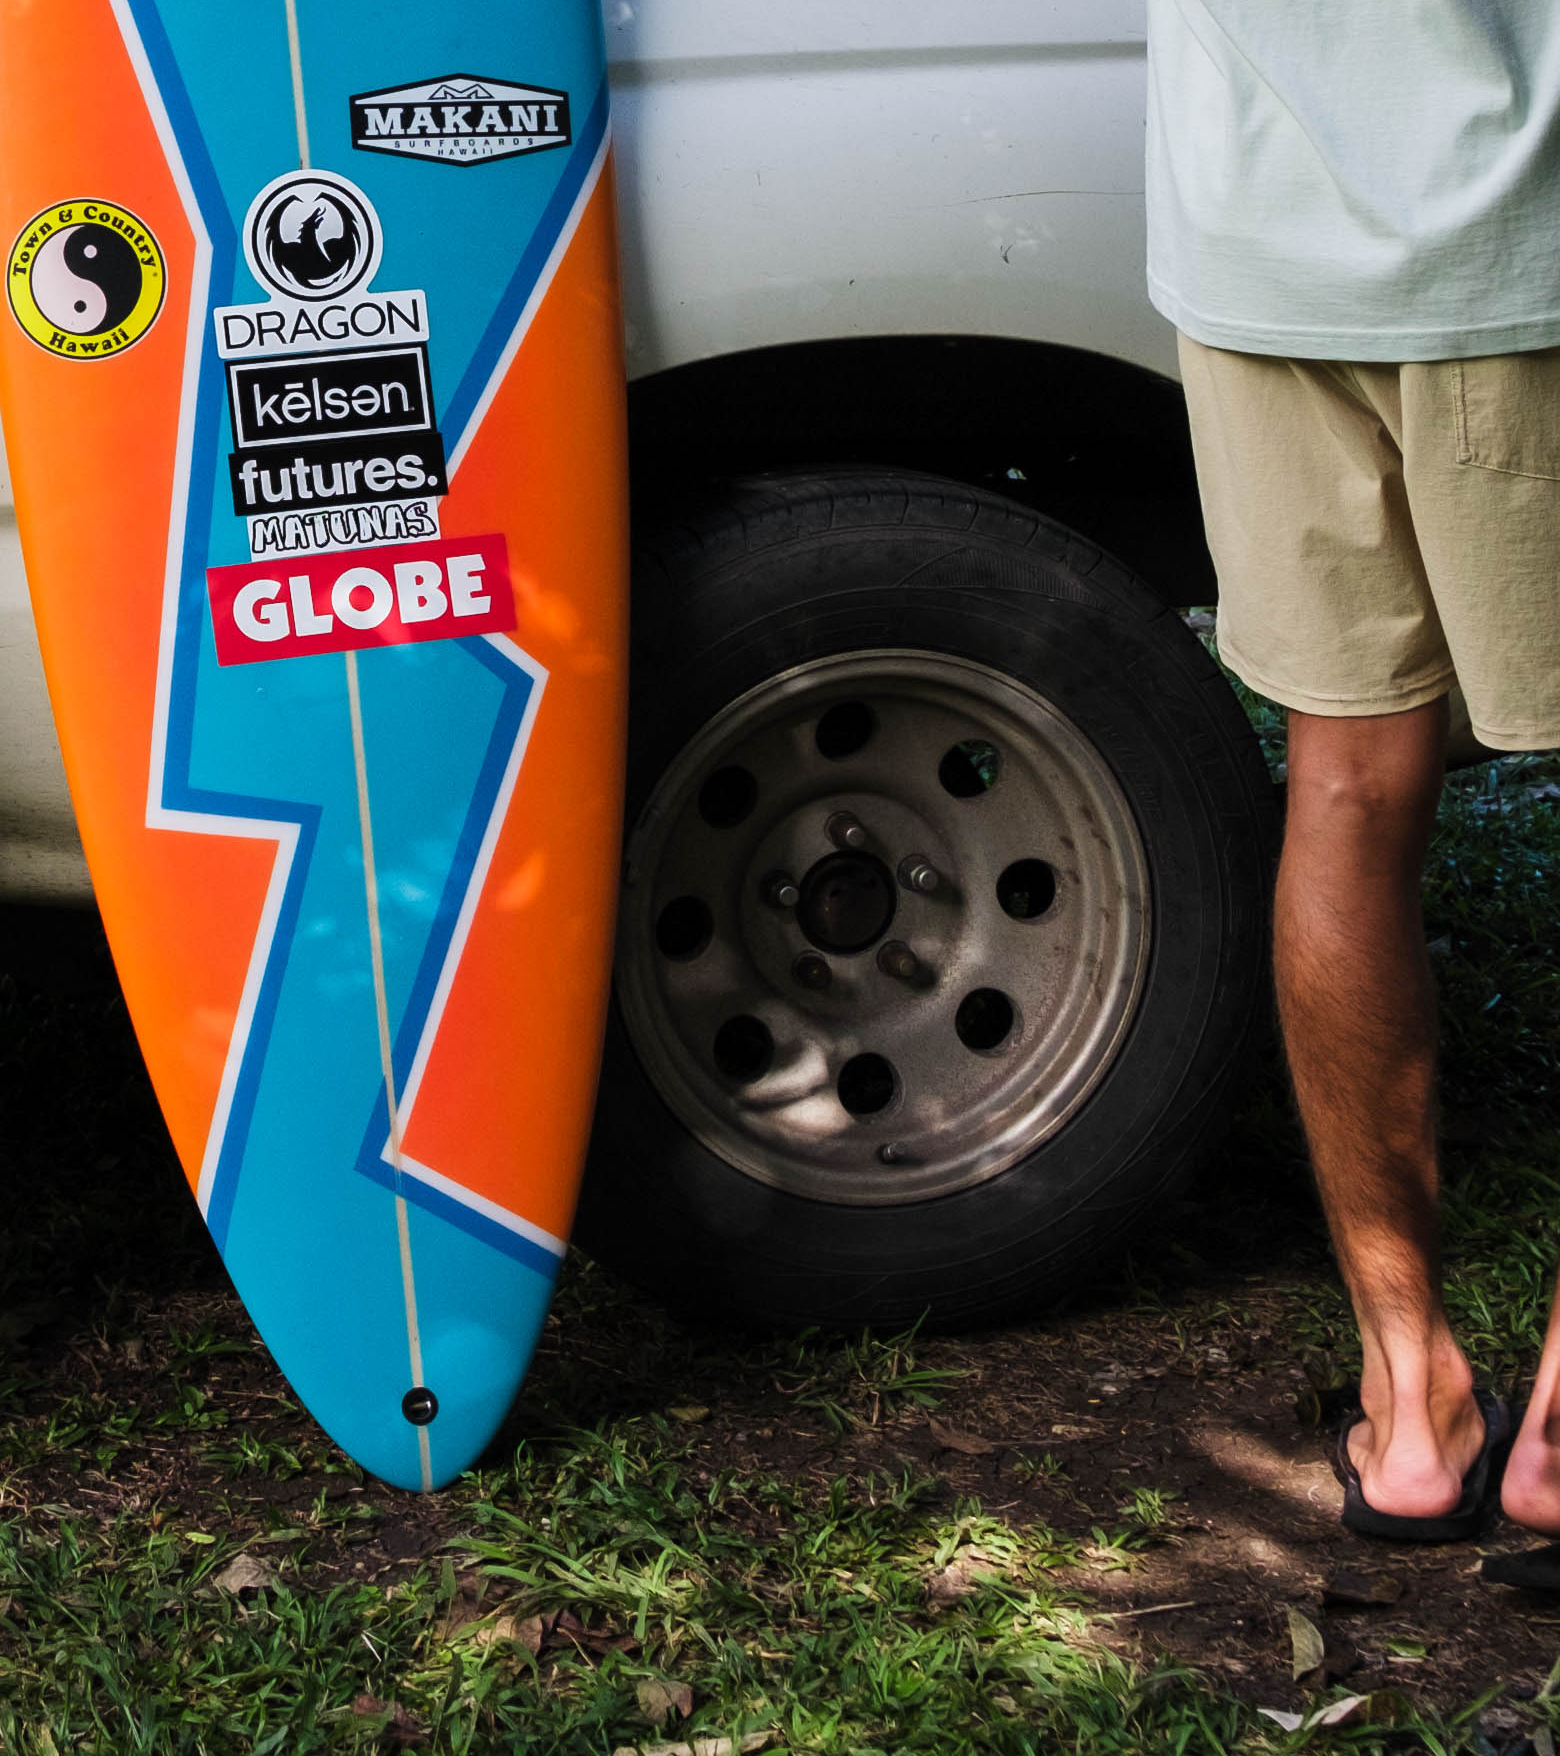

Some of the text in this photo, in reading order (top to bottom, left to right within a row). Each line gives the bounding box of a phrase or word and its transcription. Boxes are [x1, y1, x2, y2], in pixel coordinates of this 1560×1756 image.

[364, 105, 559, 136] MAKANI
[394, 137, 534, 149] SURFBOARDS
[438, 148, 495, 156] HAWAII
[13, 206, 156, 277] Town & Country
[49, 328, 130, 353] Hawaii
[223, 298, 421, 350] DRAGON
[238, 453, 439, 505] futures.
[252, 501, 438, 554] MATUNAS
[232, 553, 492, 642] GLOBE
